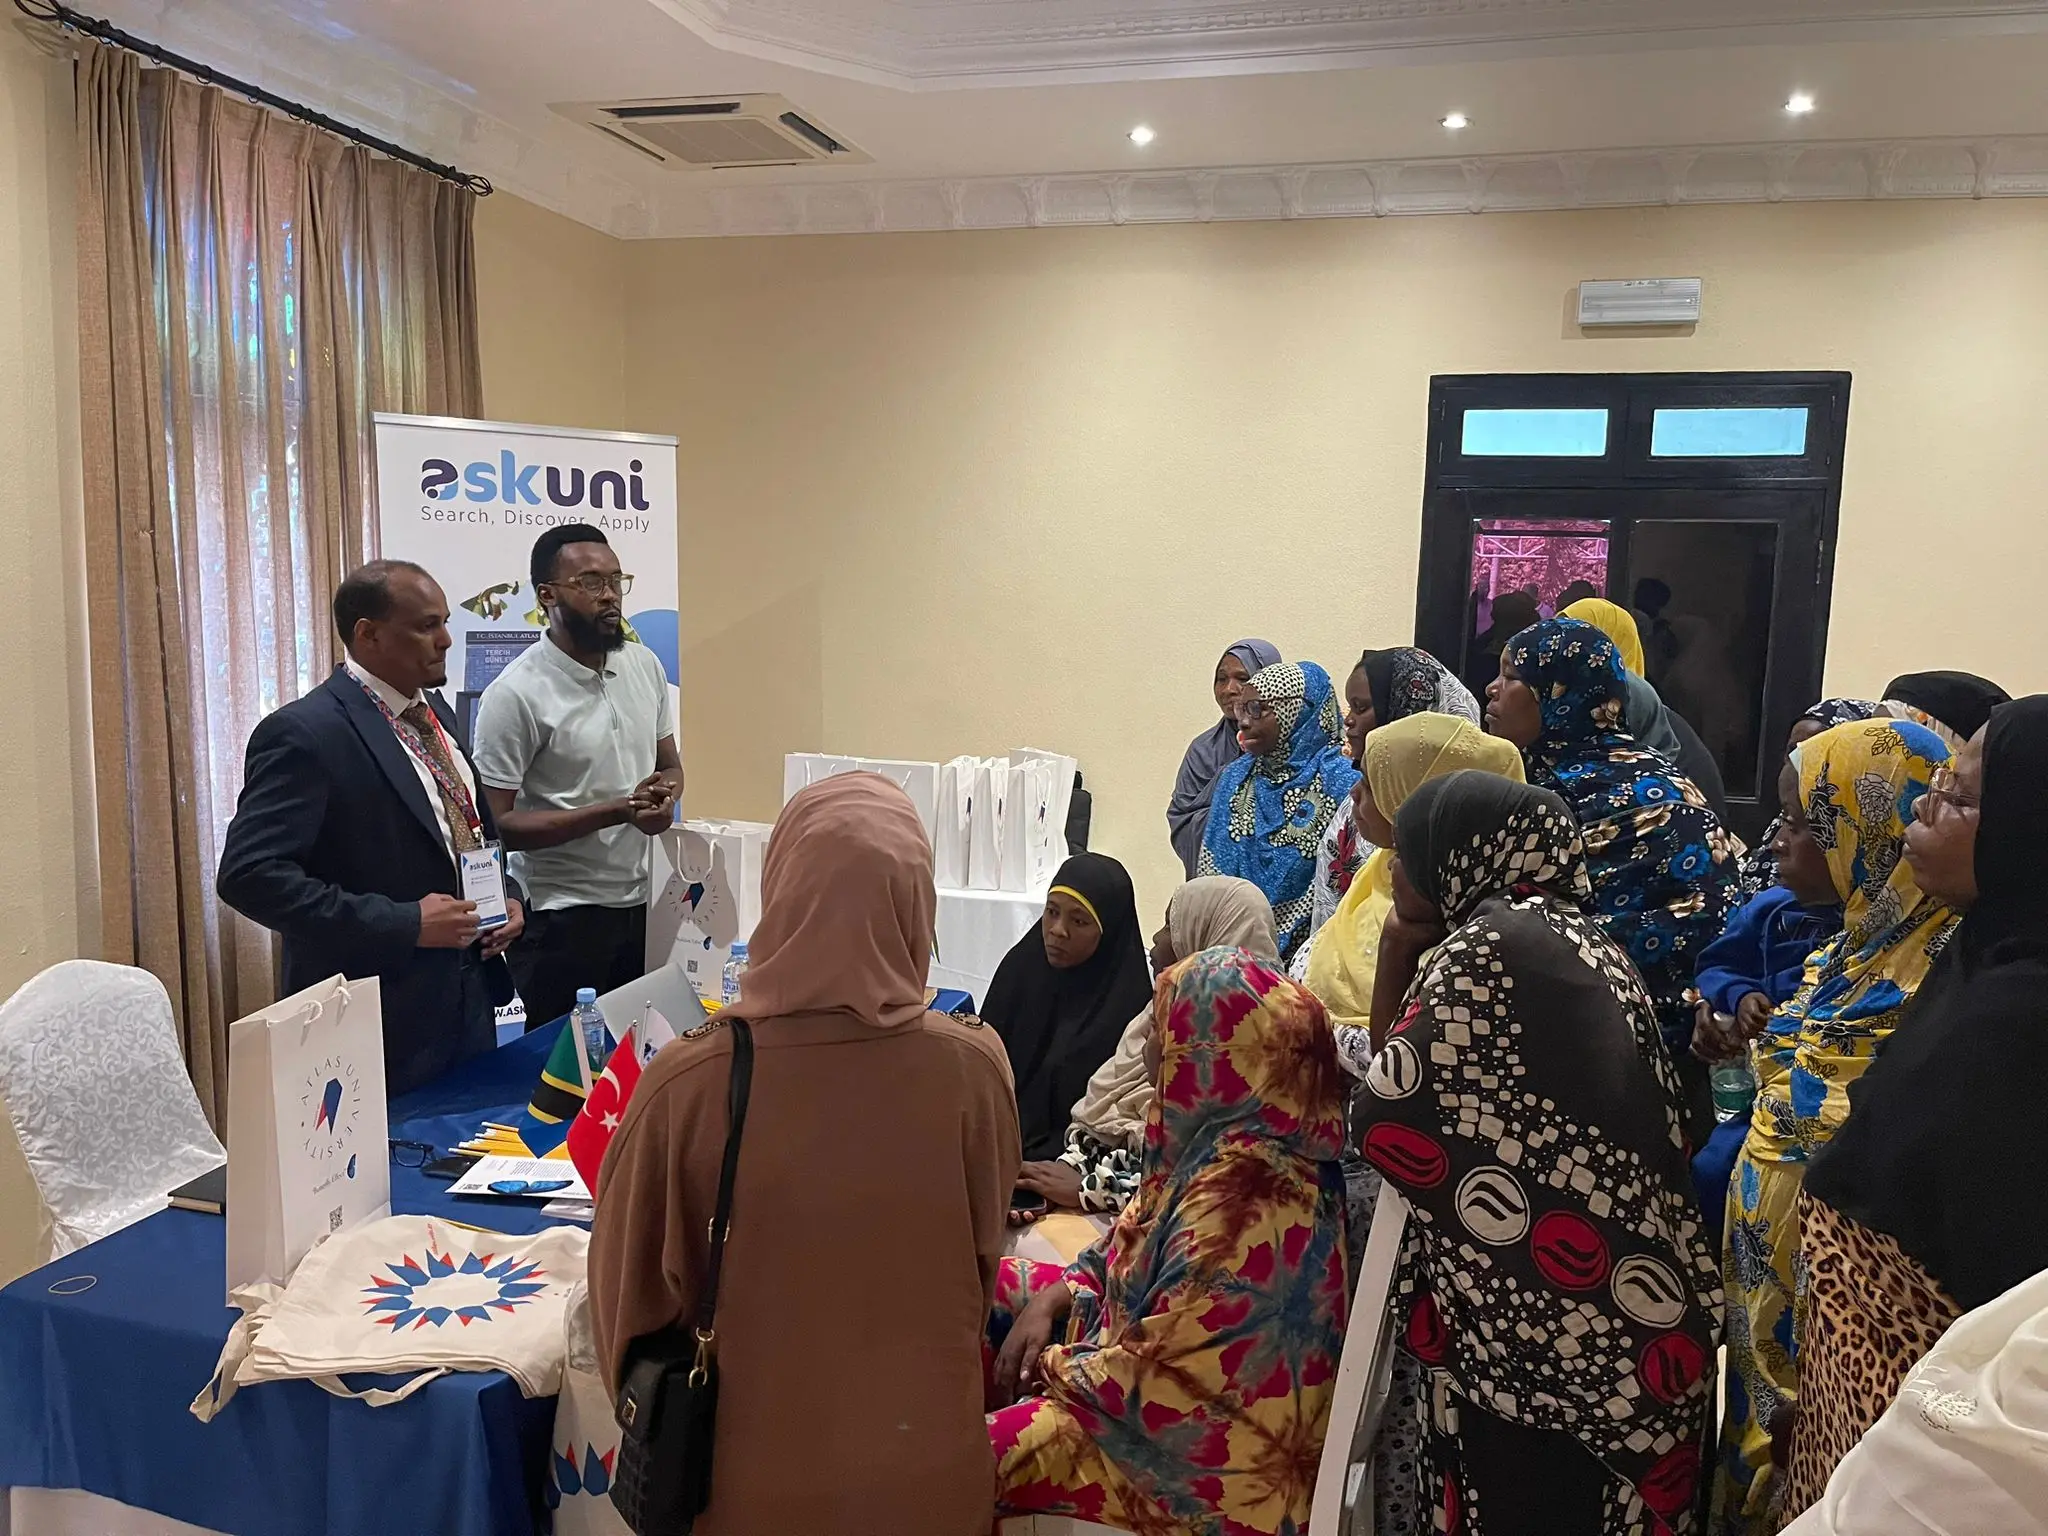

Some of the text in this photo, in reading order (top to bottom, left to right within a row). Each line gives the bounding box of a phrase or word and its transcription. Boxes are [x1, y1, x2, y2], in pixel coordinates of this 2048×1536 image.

[421, 449, 650, 511] askuni
[421, 505, 495, 525] Search,
[598, 515, 650, 533] Apply
[301, 1055, 341, 1106] ATLAS
